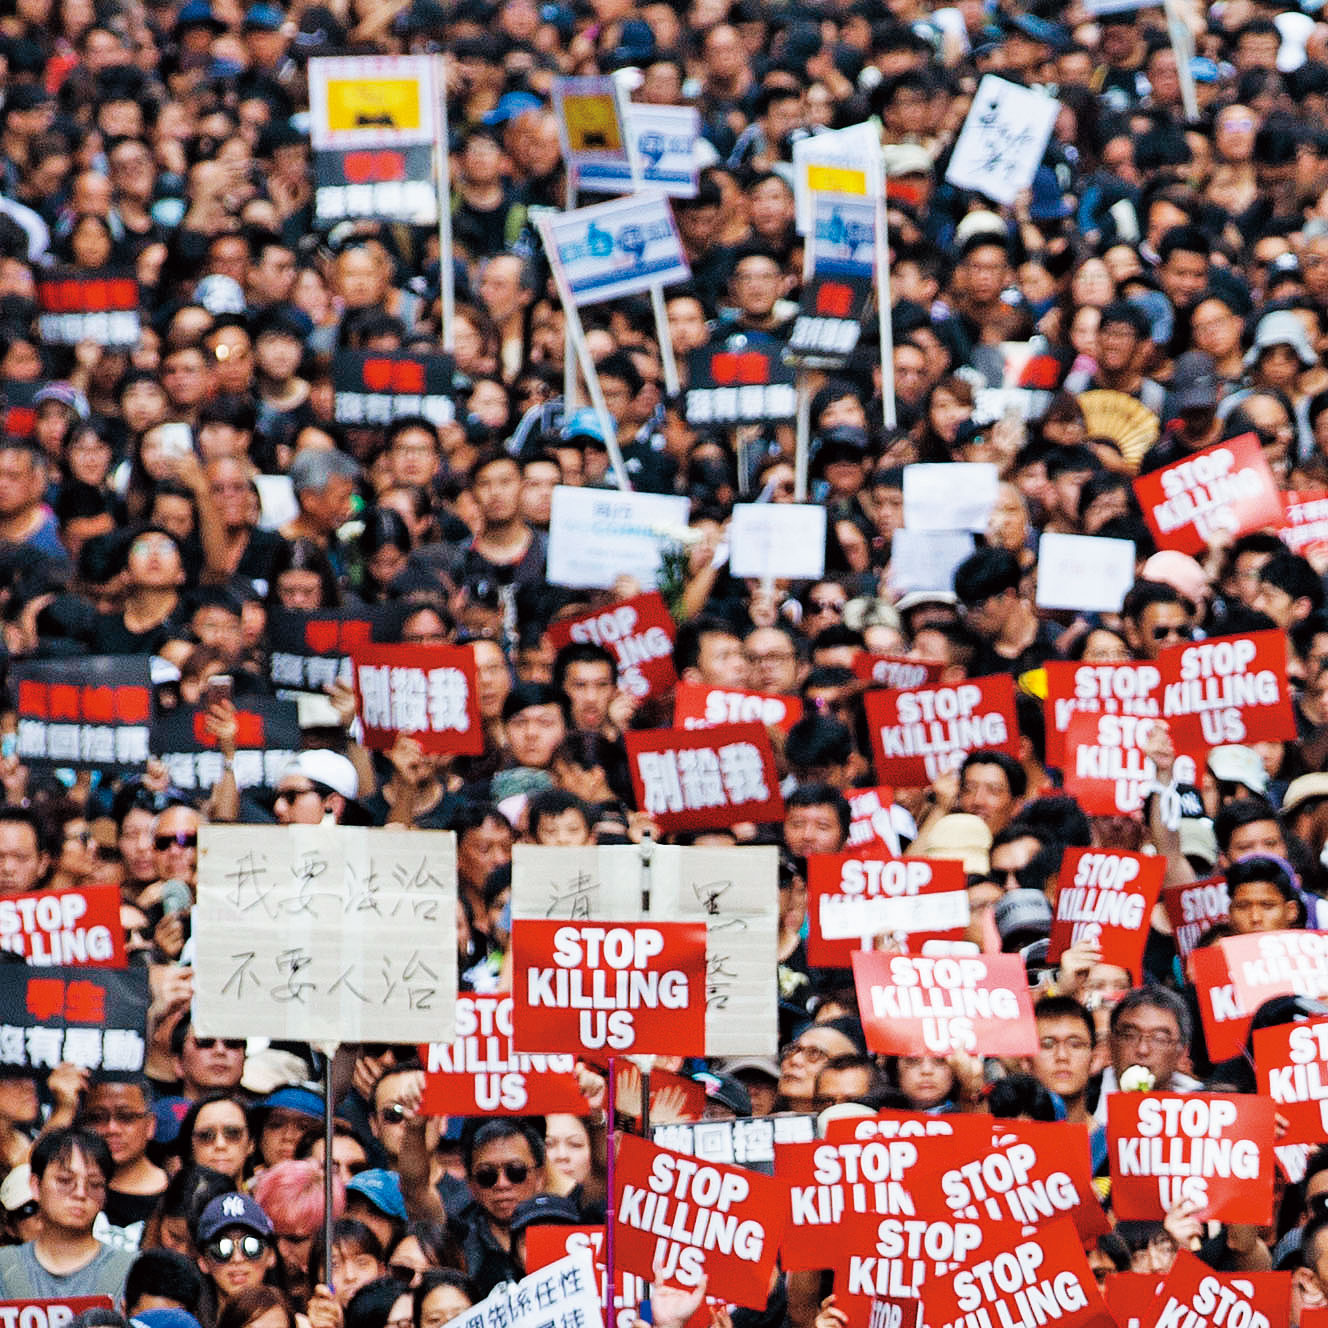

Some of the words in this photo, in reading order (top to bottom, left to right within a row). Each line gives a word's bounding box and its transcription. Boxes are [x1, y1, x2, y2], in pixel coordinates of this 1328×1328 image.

[1180, 641, 1256, 678] STOP
[1164, 672, 1278, 716] KILLING
[226, 851, 445, 925] 我要法治
[553, 928, 664, 968] STOP
[220, 953, 439, 1014] 不要人治
[527, 969, 689, 1009] KILLING
[578, 1009, 636, 1049] US
[648, 1153, 750, 1210] STOP
[619, 1185, 765, 1263] KILLING
[654, 1251, 706, 1286] US
[952, 1241, 1046, 1309] STOP
